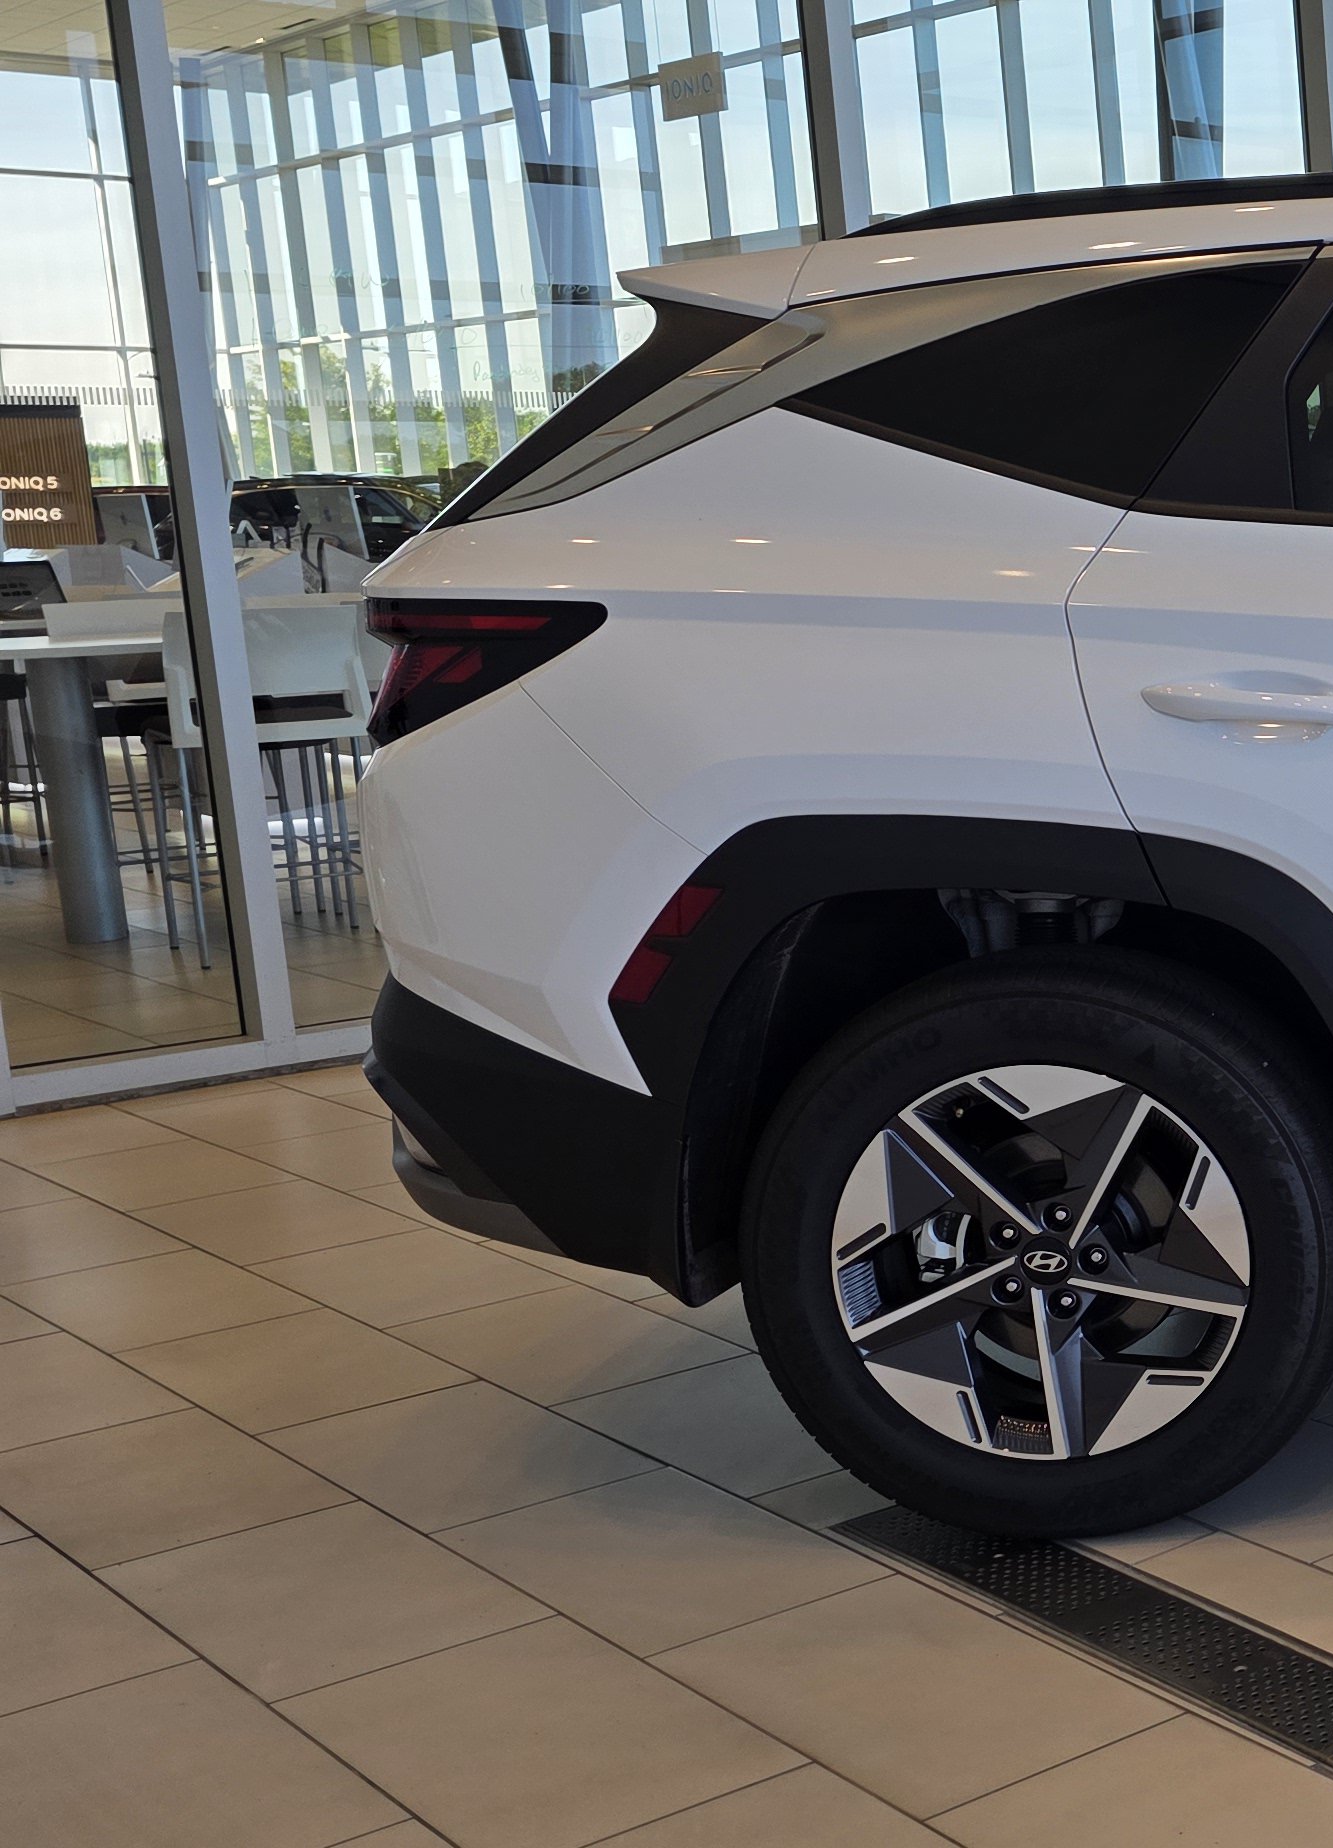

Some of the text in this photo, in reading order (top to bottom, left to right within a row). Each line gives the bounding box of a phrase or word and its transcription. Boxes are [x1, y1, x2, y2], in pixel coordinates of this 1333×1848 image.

[665, 71, 713, 101] IONIQ
[0, 475, 58, 491] ONIQ 5
[1, 507, 62, 522] ONIQ 6
